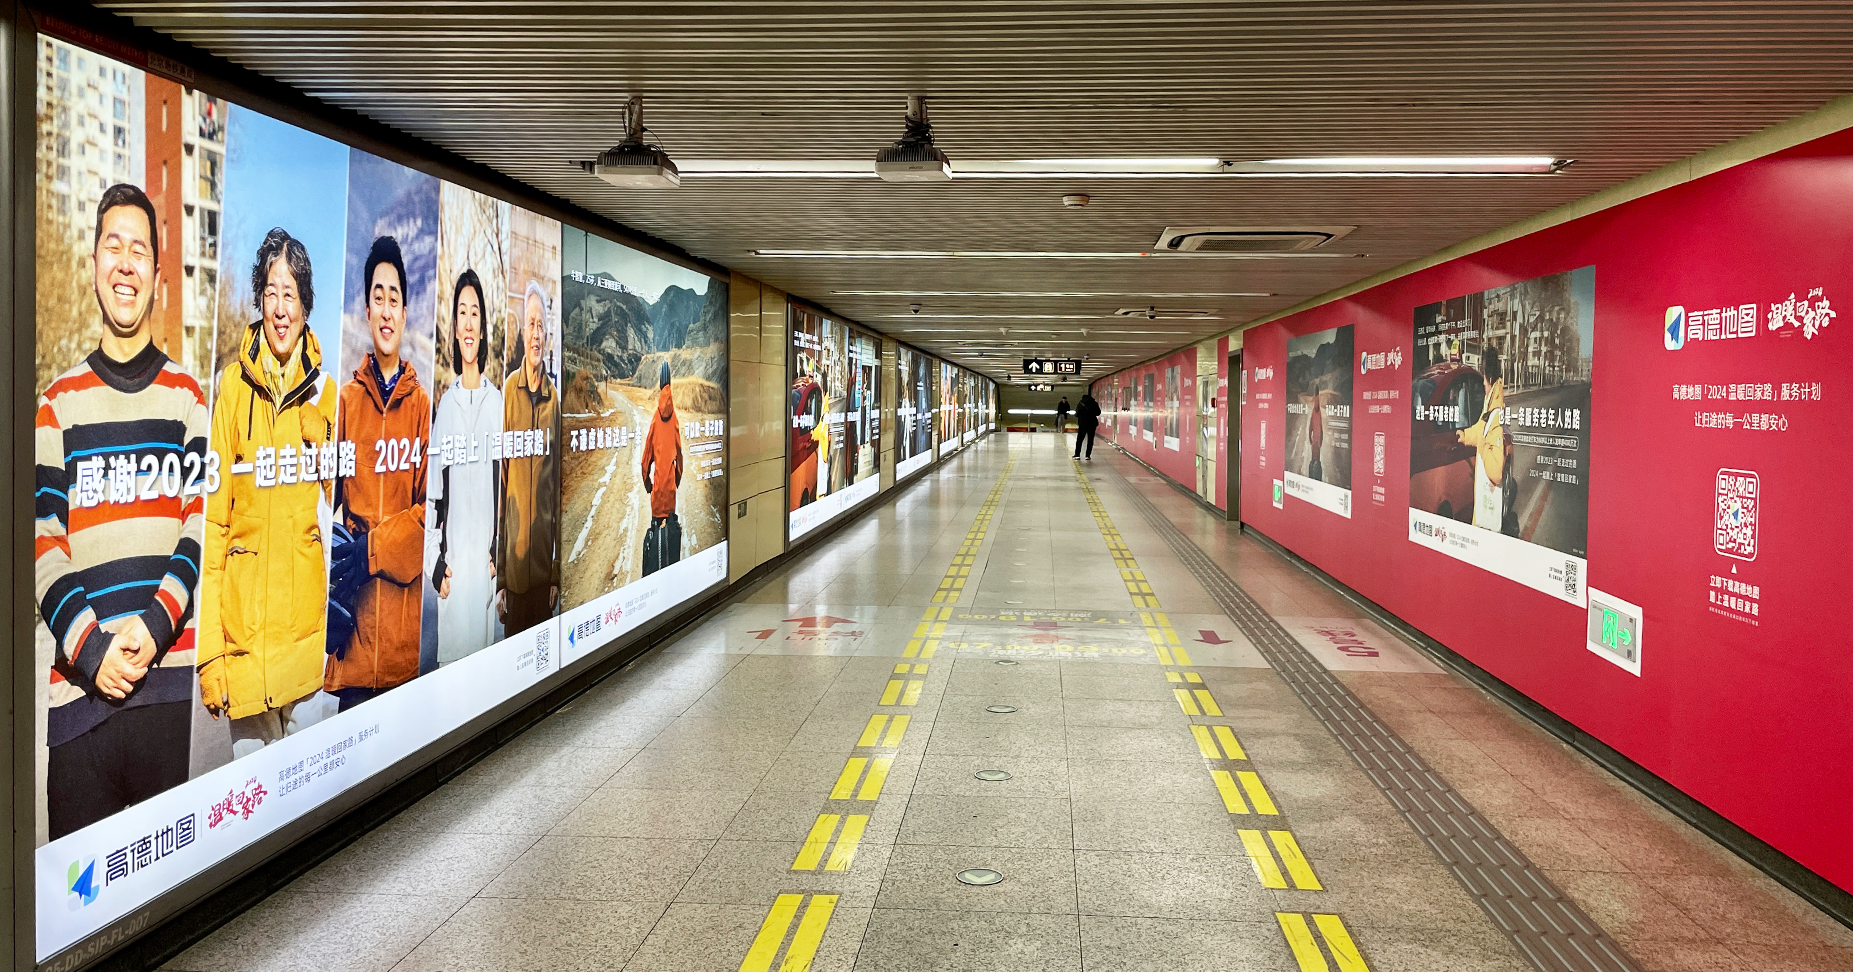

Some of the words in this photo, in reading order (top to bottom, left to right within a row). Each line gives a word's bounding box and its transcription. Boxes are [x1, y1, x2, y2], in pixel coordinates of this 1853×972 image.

[1687, 304, 1757, 342] 高德地图
[1767, 292, 1837, 340] 温暖回家路
[1415, 404, 1460, 422] 这是一条不服老的路
[1499, 406, 1581, 430] 也是一条服务老年人的路
[1694, 412, 1788, 431] 让归途的每一公里都安心
[375, 437, 421, 473] 2024
[427, 428, 550, 466] 一起踏上「温暖回家路」
[75, 451, 221, 507] 感谢2023
[231, 440, 356, 488] 一起走过的路
[1709, 574, 1760, 600] 立即下载高德地图
[1709, 590, 1759, 616] 踏上温暖回家路
[278, 755, 347, 797] 让归途的每一公里都安心
[105, 812, 195, 887] 高德地图
[208, 783, 268, 829] 温暖回家路
